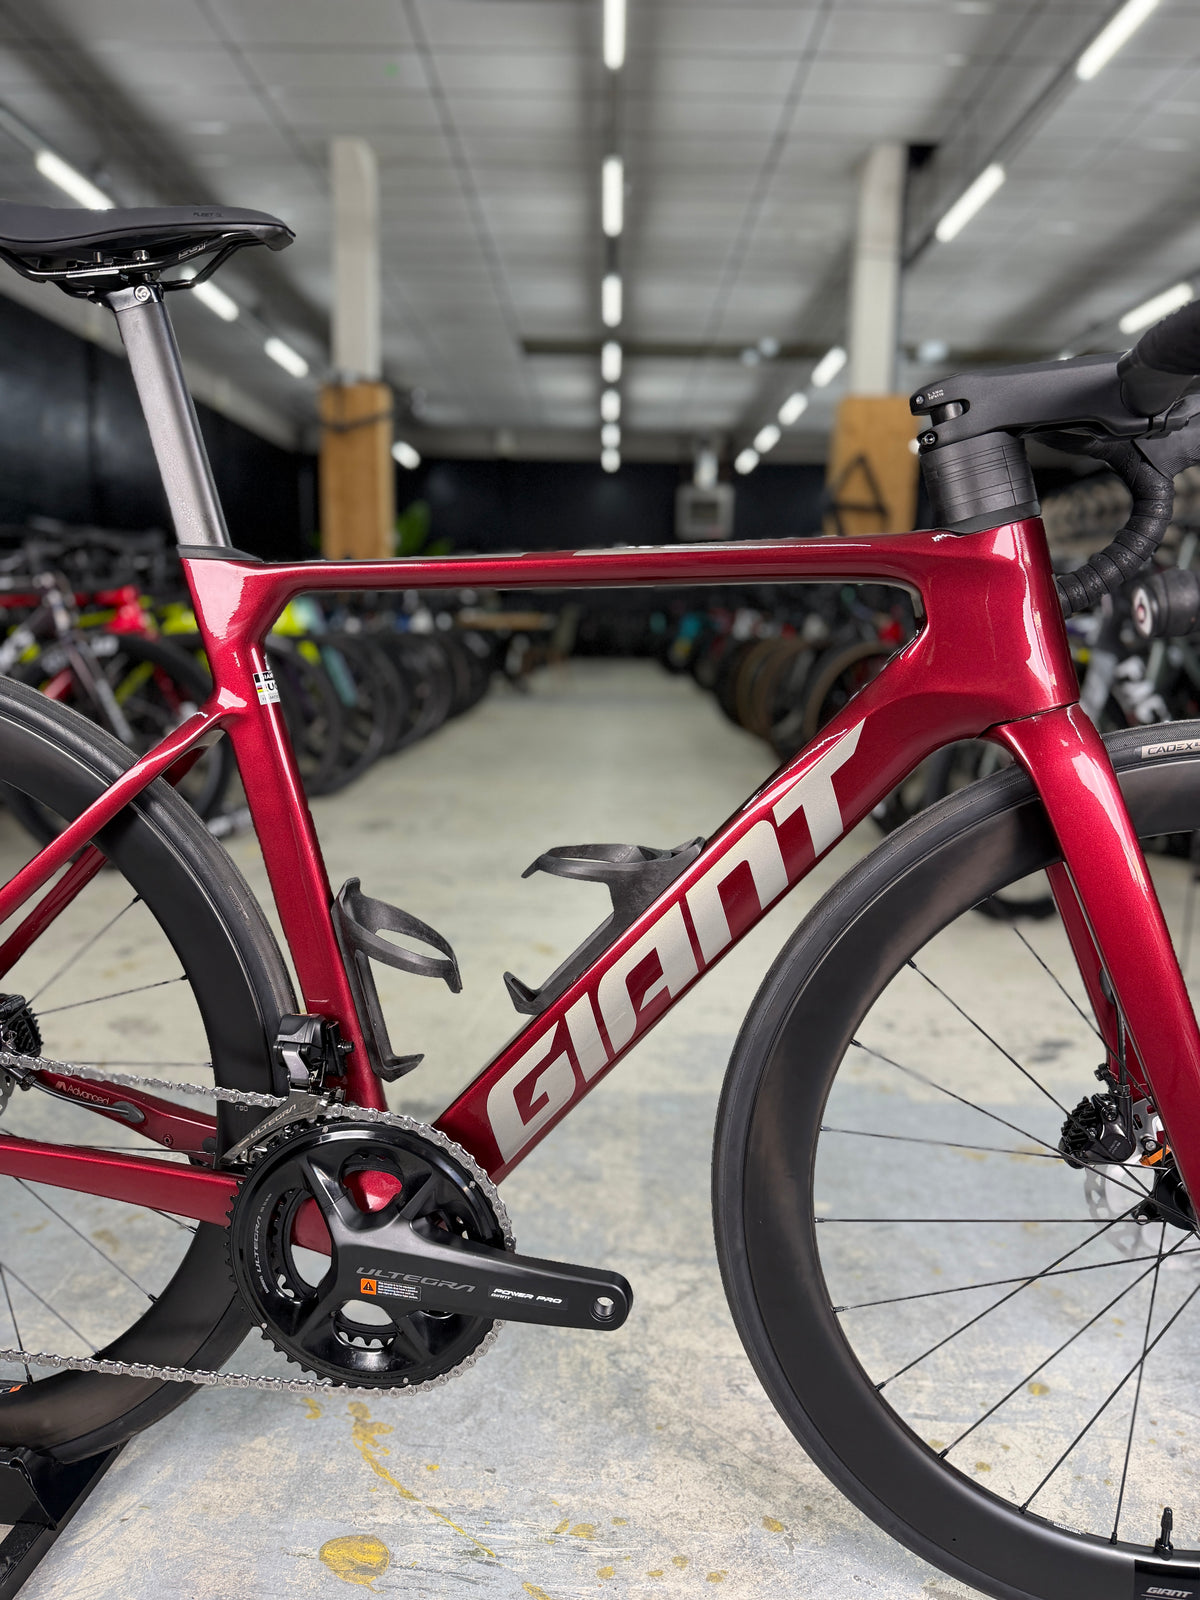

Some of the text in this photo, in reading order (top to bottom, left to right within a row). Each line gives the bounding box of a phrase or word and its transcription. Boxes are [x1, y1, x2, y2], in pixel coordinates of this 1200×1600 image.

[1147, 742, 1193, 755] CADEX
[487, 717, 866, 1165] GIANT
[67, 1084, 110, 1105] Advanced
[250, 1103, 297, 1139] ULTEGRA
[253, 1215, 262, 1273] ULTEGRA
[356, 1266, 476, 1293] ULTEGRA
[493, 1288, 563, 1304] POWER PRO
[1146, 1586, 1193, 1598] GIANT
